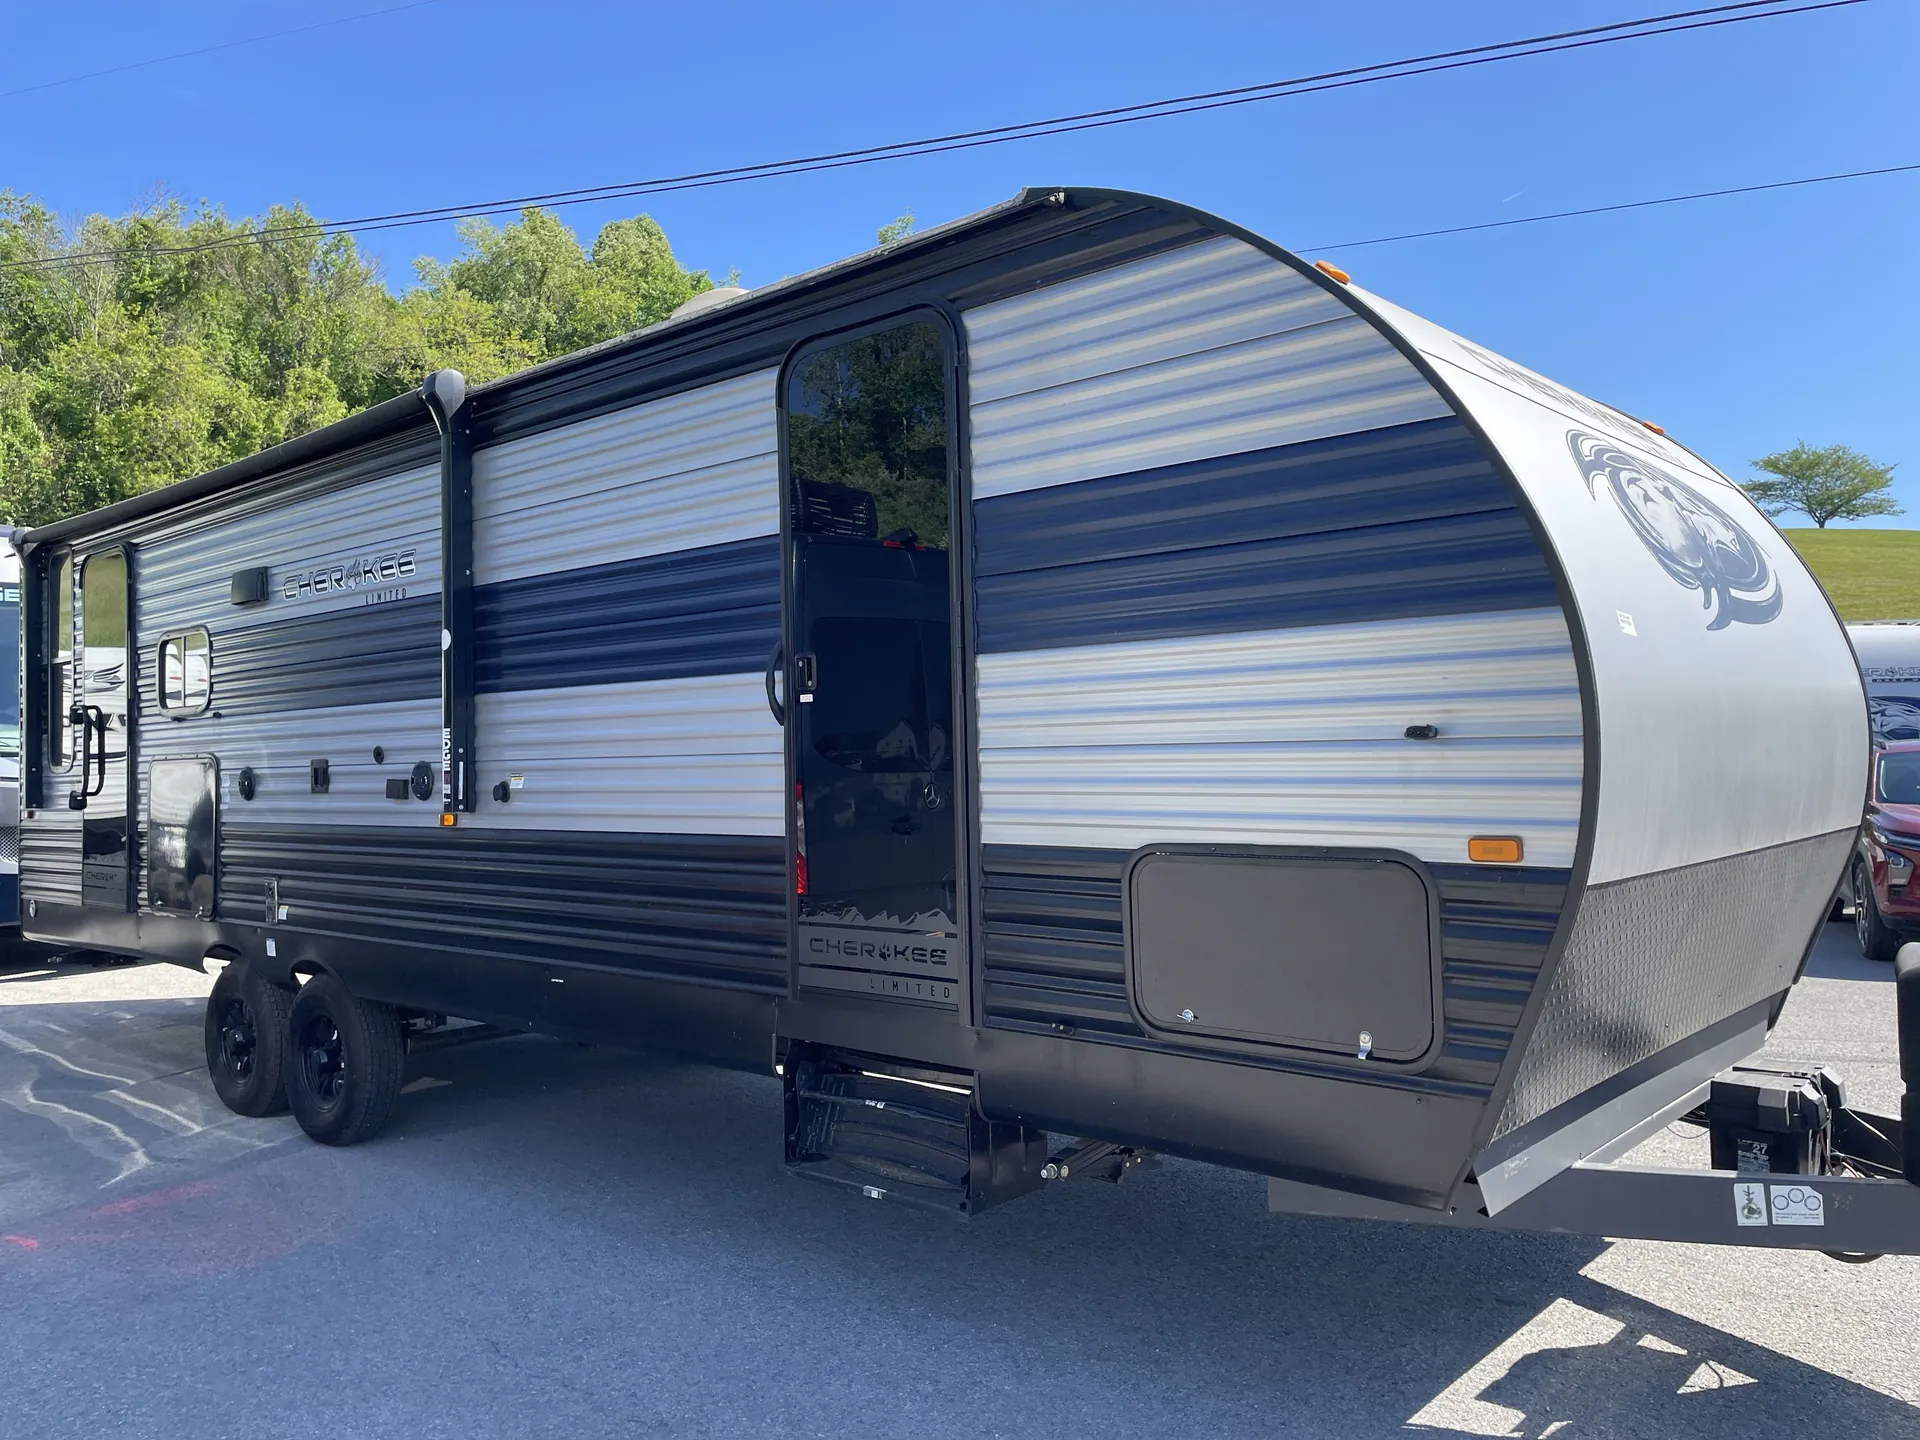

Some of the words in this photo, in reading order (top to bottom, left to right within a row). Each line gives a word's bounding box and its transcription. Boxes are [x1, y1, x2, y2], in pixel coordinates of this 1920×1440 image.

[282, 549, 417, 601] CHEROKEE
[366, 588, 408, 604] LIMITED
[443, 728, 451, 771] EDGE
[809, 938, 947, 965] CHEROKEE
[870, 978, 951, 998] LIMITED
[1752, 1143, 1768, 1155] 27
